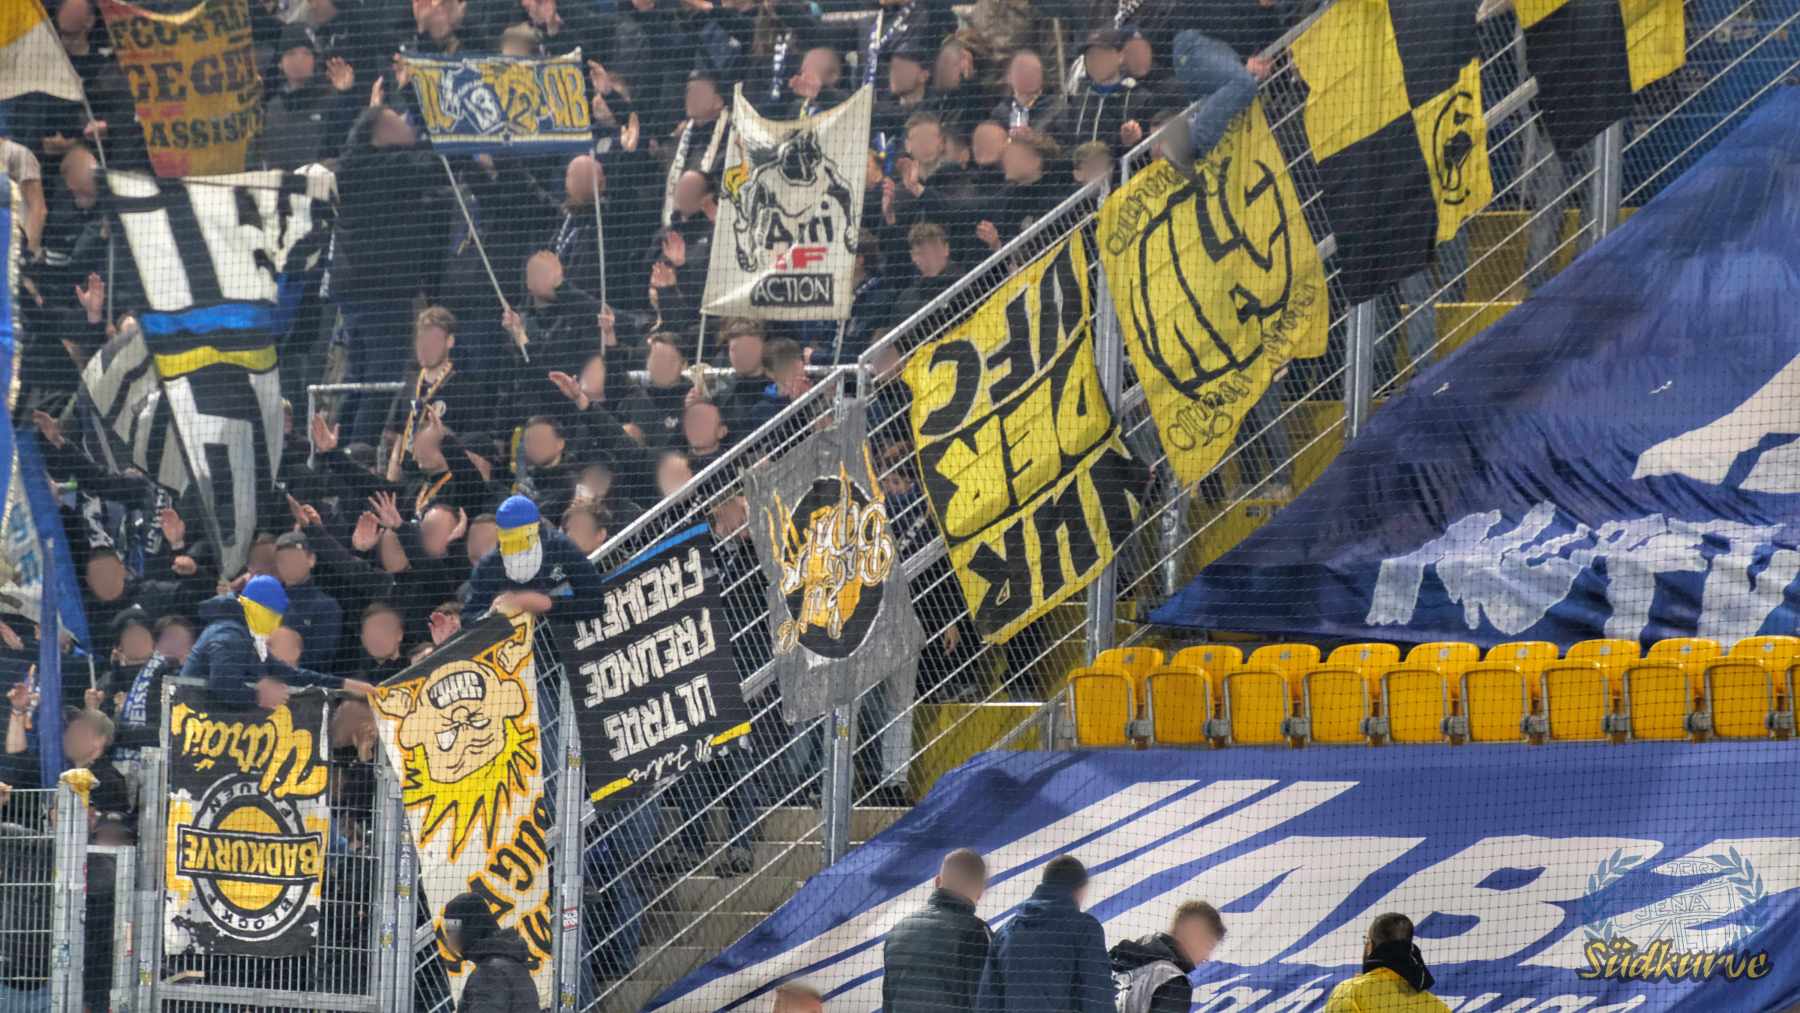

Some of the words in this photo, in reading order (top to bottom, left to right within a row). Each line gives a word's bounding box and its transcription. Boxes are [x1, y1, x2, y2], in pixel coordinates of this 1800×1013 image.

[753, 275, 830, 302] ACTION
[935, 331, 1112, 538] DER
[573, 546, 705, 651] FREIHEIT
[578, 606, 717, 709] FREUNDE
[602, 673, 718, 762] ULTRAS
[182, 832, 321, 879] BADKURVE
[220, 896, 297, 932] BLOCK
